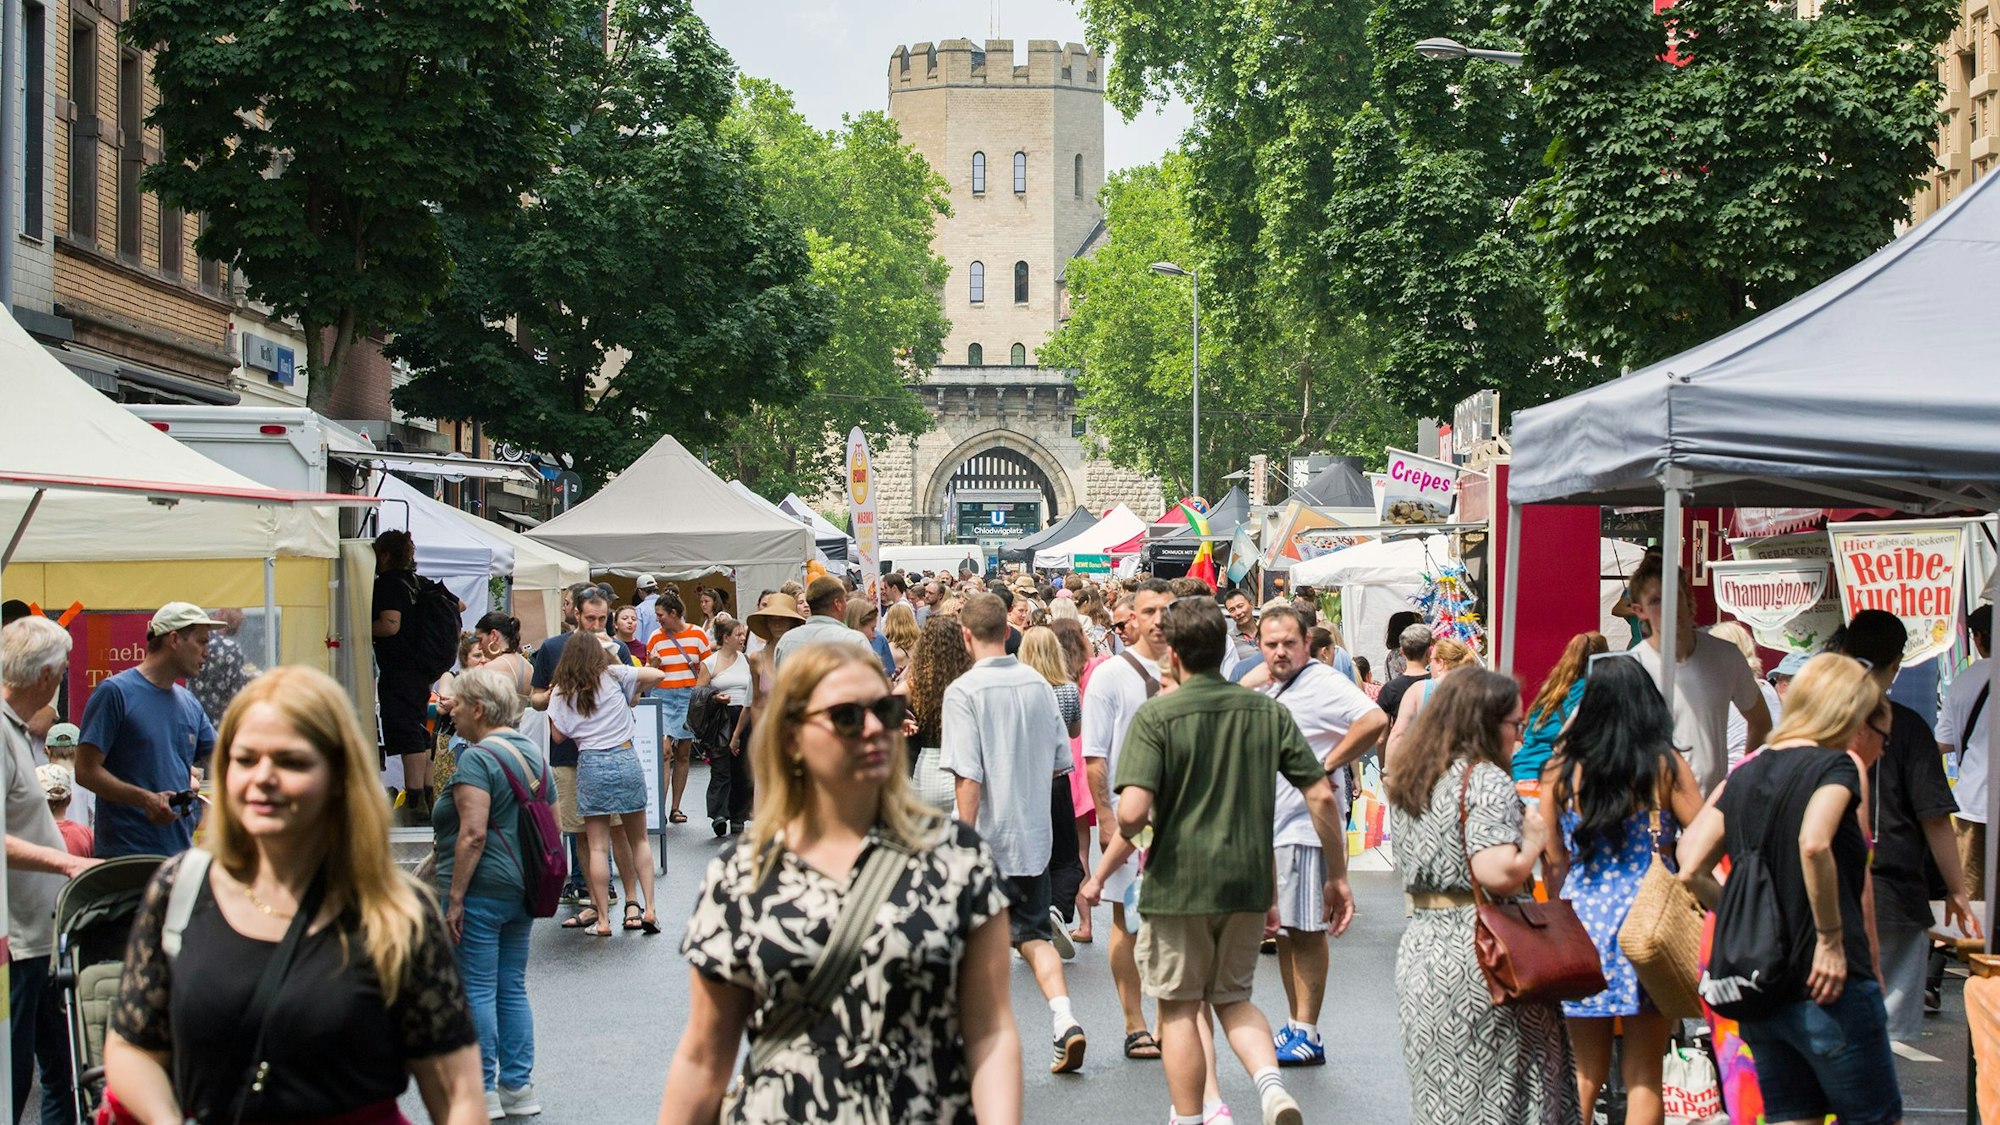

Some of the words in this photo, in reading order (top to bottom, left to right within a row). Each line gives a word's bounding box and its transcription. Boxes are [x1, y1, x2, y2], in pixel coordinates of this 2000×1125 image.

[991, 511, 1005, 525] U
[974, 526, 1024, 535] Chlodwigplatz
[1843, 540, 1875, 552] Hier
[1877, 538, 1899, 550] gibts
[1901, 538, 1915, 546] die
[1916, 535, 1955, 547] leckeren
[1758, 546, 1828, 560] GEBACKENER
[1849, 548, 1953, 586] Reibe-
[1725, 579, 1818, 610] Champignons
[1846, 582, 1952, 620] kuchen
